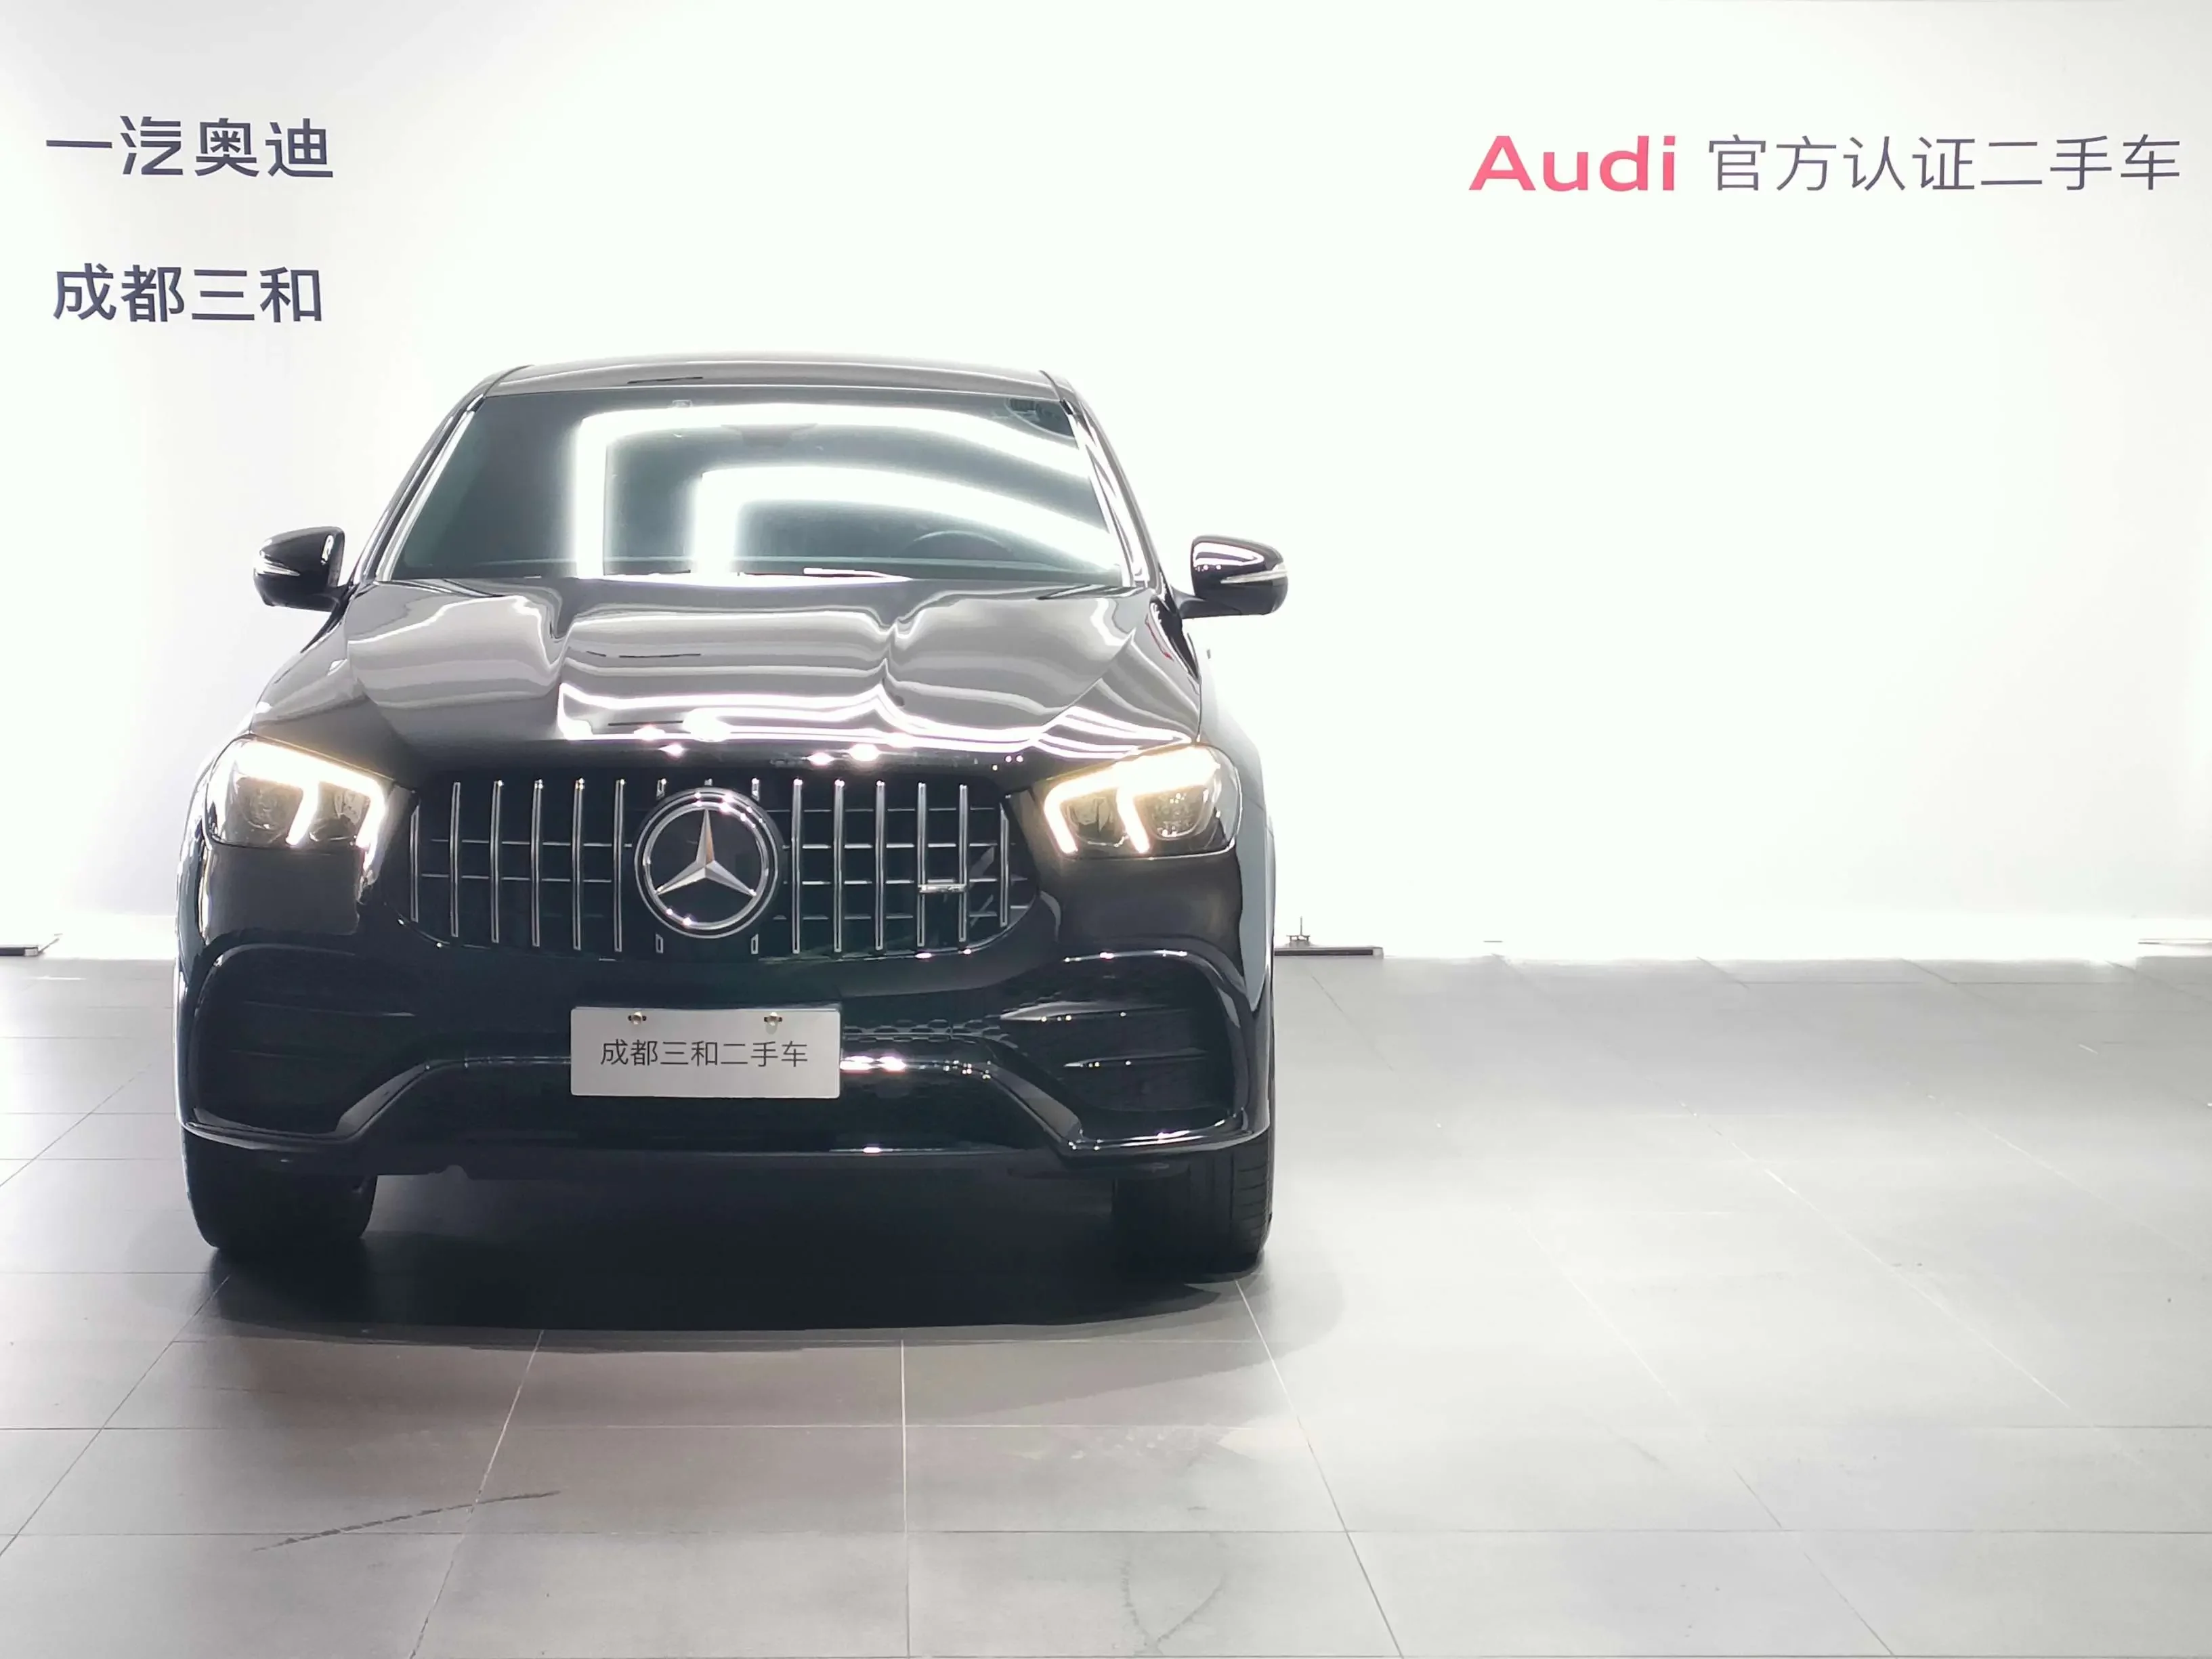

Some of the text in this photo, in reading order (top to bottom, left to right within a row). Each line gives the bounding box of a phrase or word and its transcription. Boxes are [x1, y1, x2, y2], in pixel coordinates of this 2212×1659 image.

[46, 116, 333, 177] 一汽奥迪
[1469, 134, 2180, 192] Audi 官方认证二手车
[54, 263, 322, 323] 成都三和
[600, 1039, 809, 1068] 成都三和二手车
